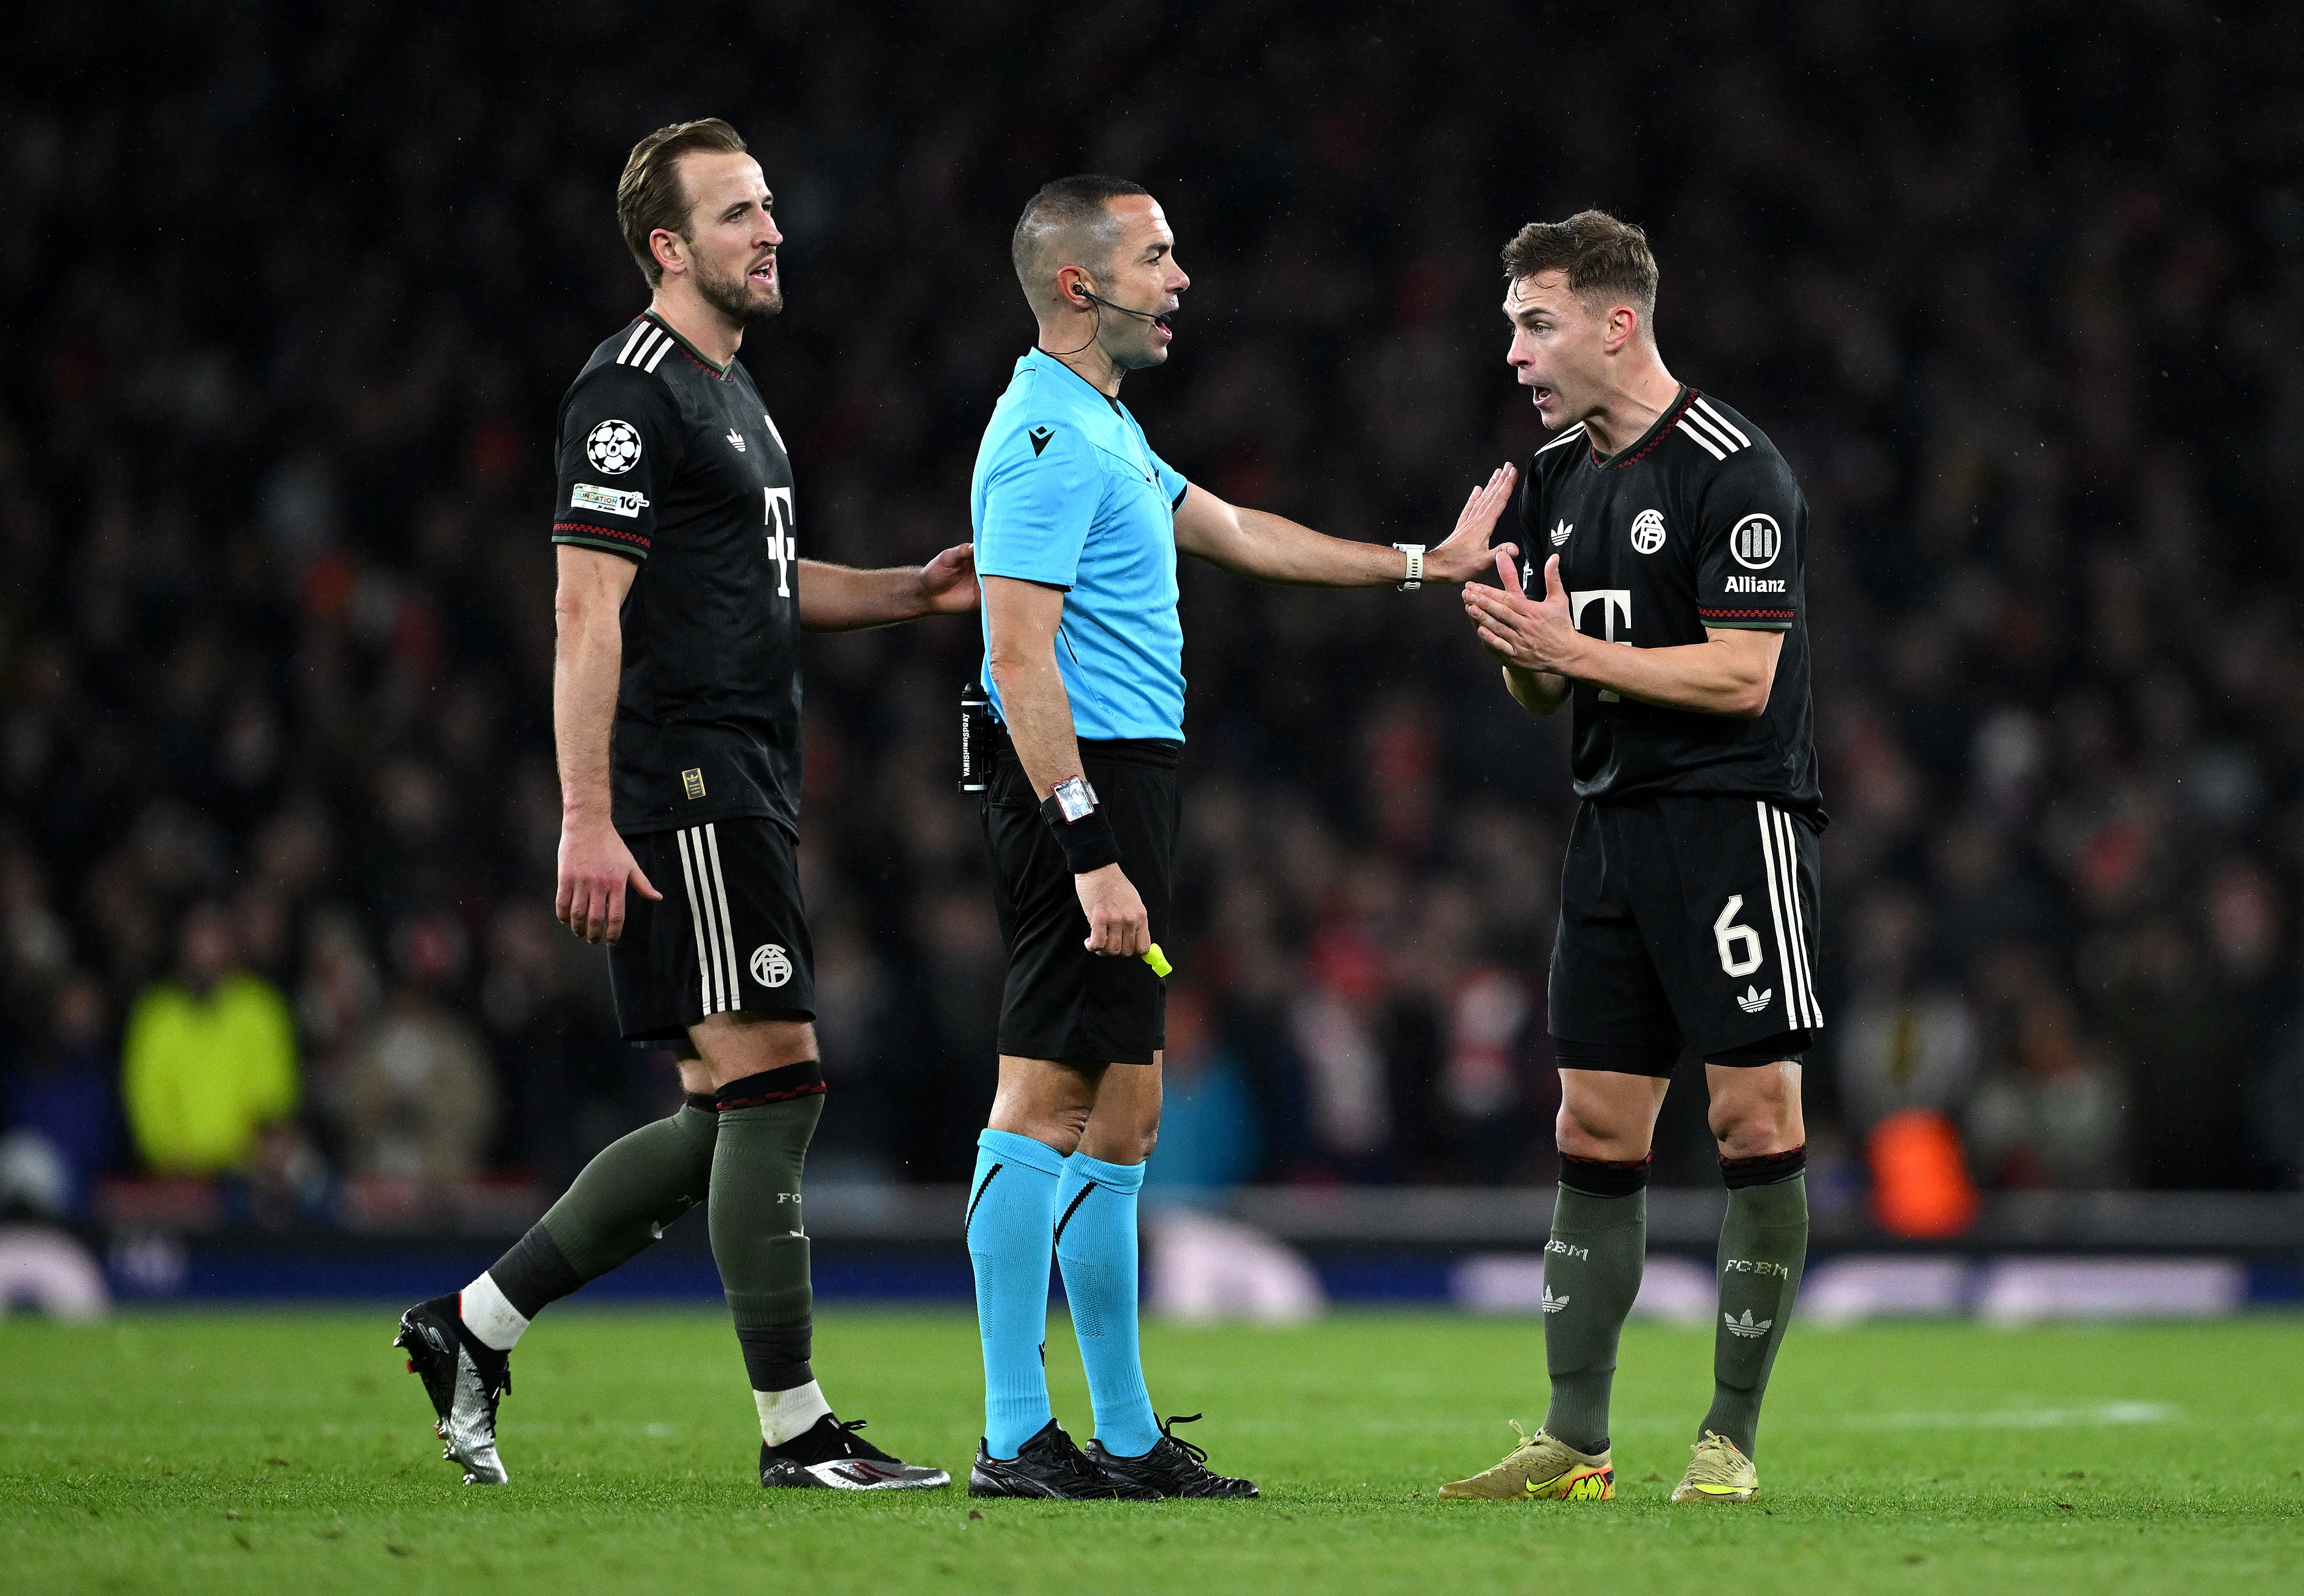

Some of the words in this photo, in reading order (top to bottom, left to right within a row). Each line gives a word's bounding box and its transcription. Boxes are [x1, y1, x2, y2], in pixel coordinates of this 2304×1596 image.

[573, 492, 618, 504] FOUNDATION
[619, 496, 637, 510] 10
[1724, 576, 1786, 592] Allianz
[1714, 894, 1763, 977] 6
[1544, 1239, 1589, 1261] CBM
[1725, 1260, 1788, 1280] FCBM
